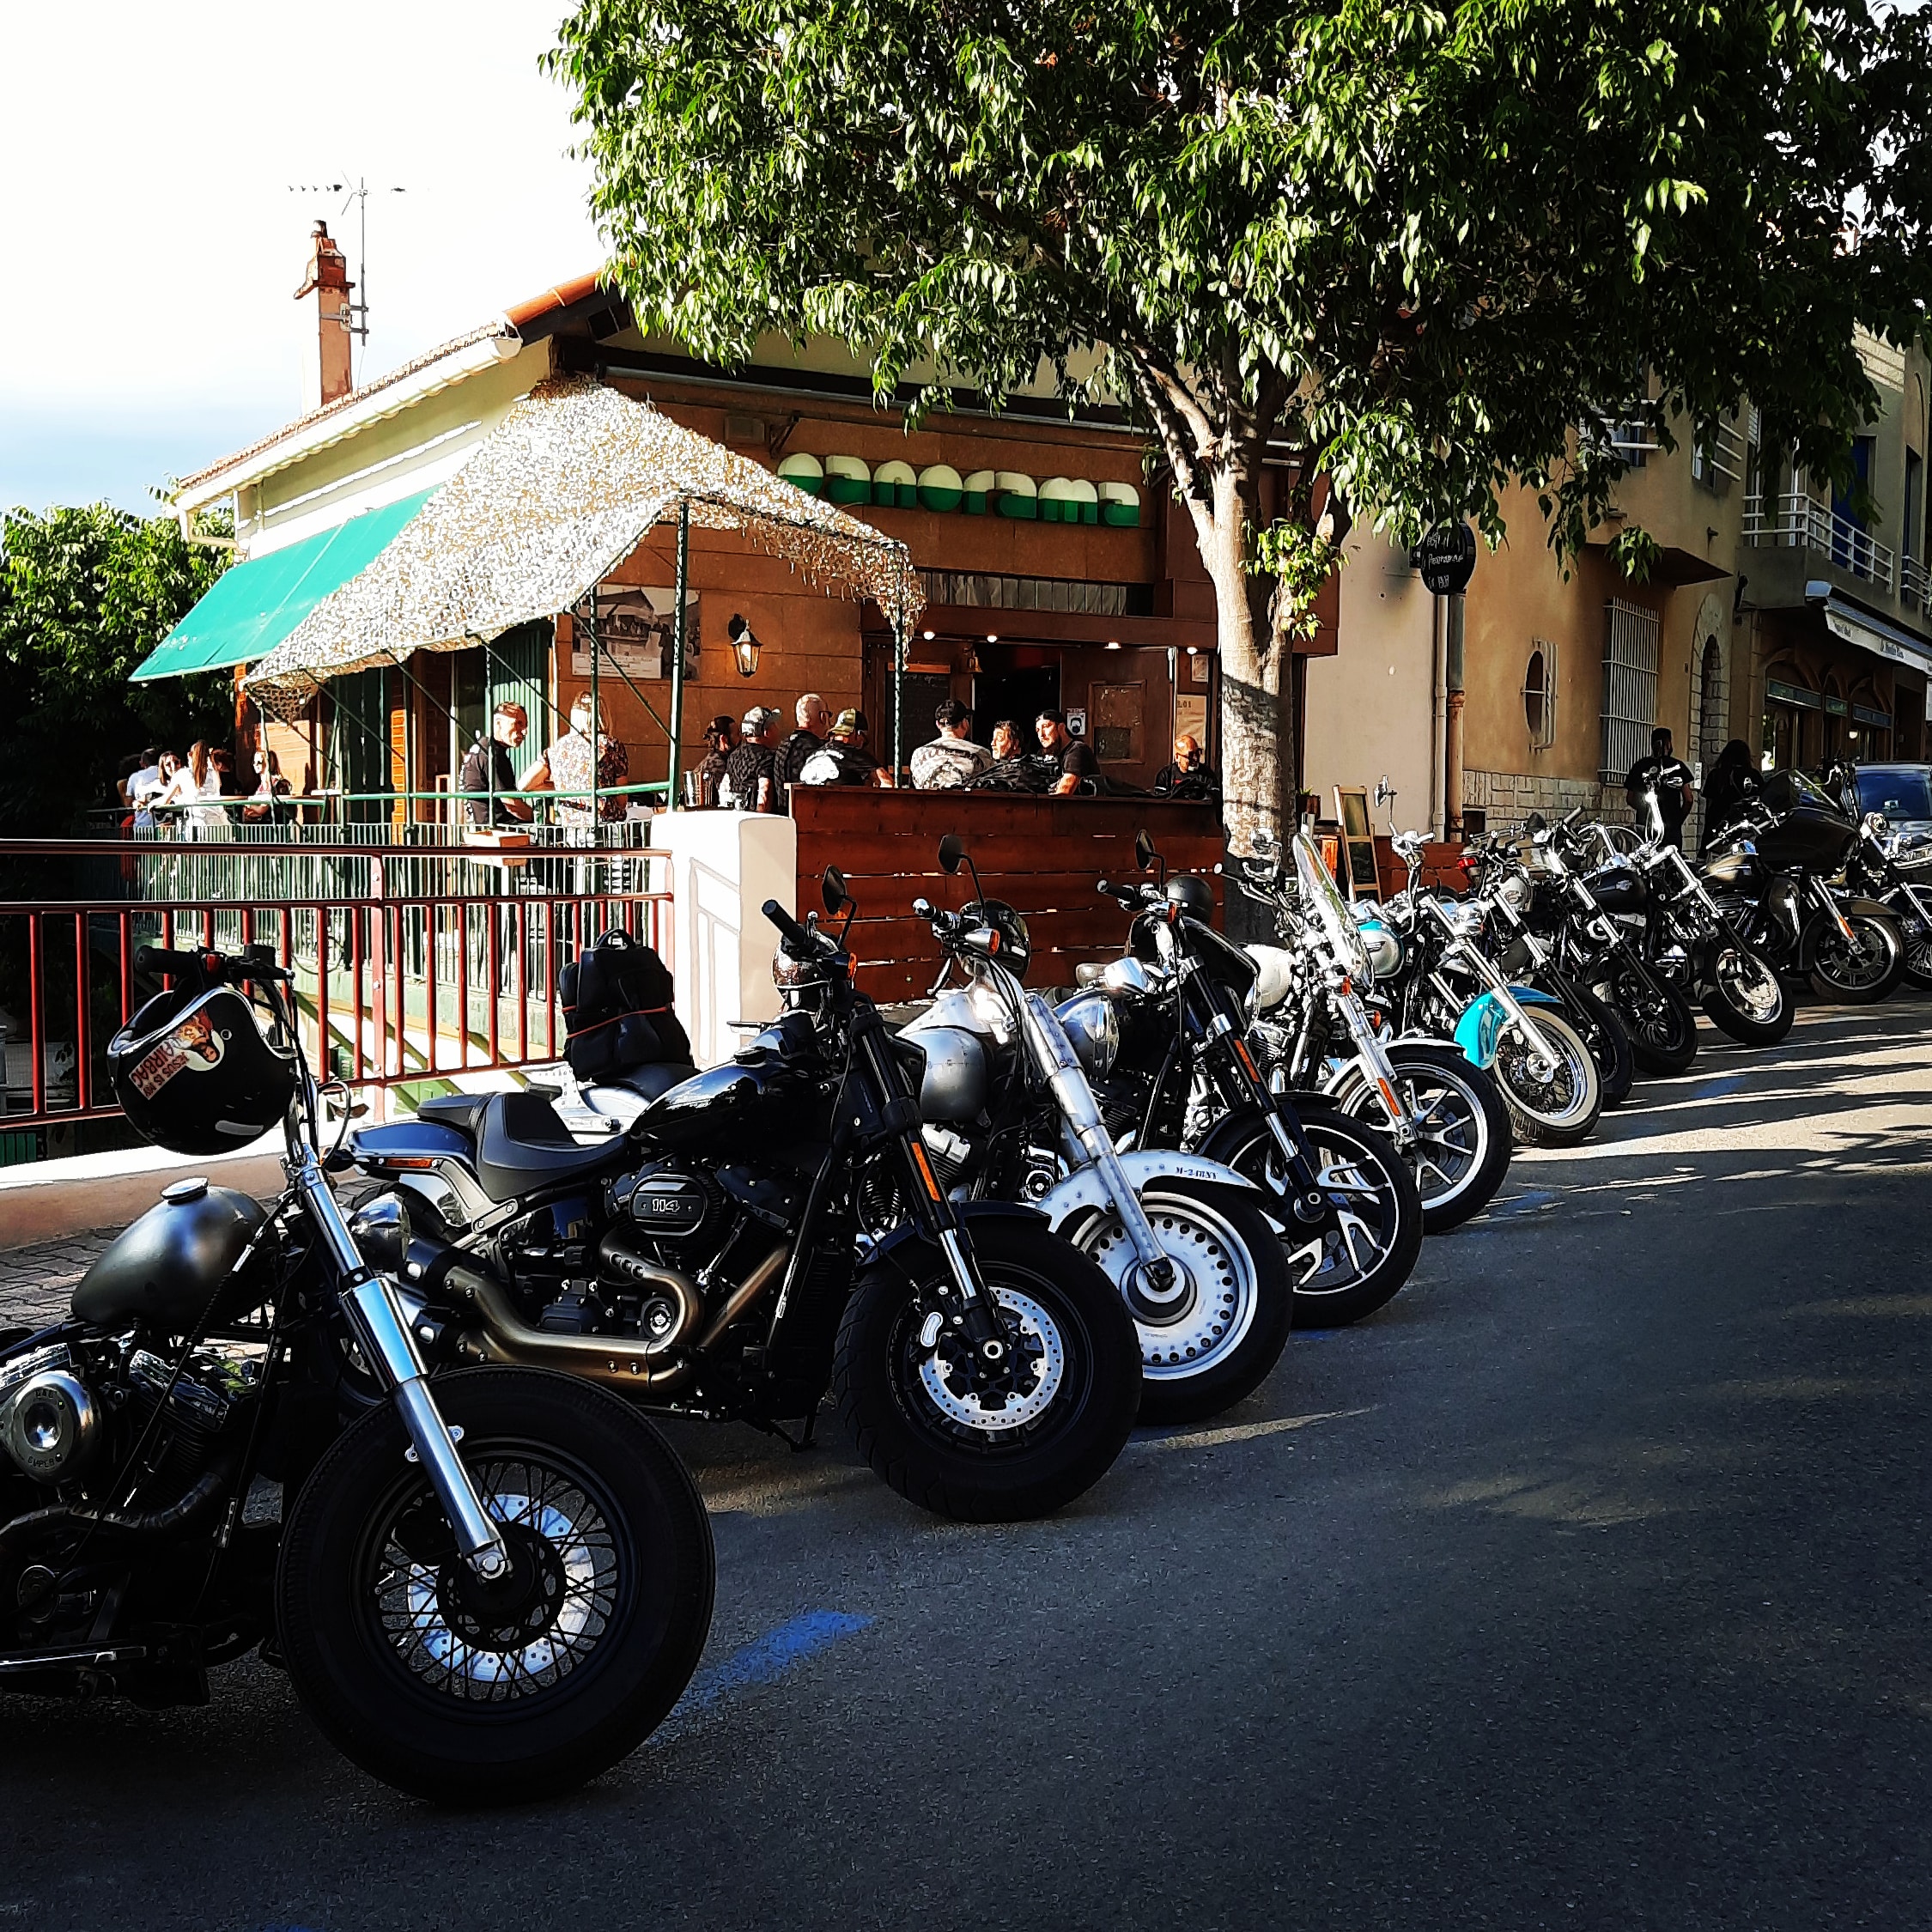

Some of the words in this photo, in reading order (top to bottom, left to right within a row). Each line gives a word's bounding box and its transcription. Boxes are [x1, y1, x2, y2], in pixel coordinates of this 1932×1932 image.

[161, 1052, 190, 1078] JESUS
[153, 1073, 166, 1086] IS
[653, 1199, 680, 1212] 114
